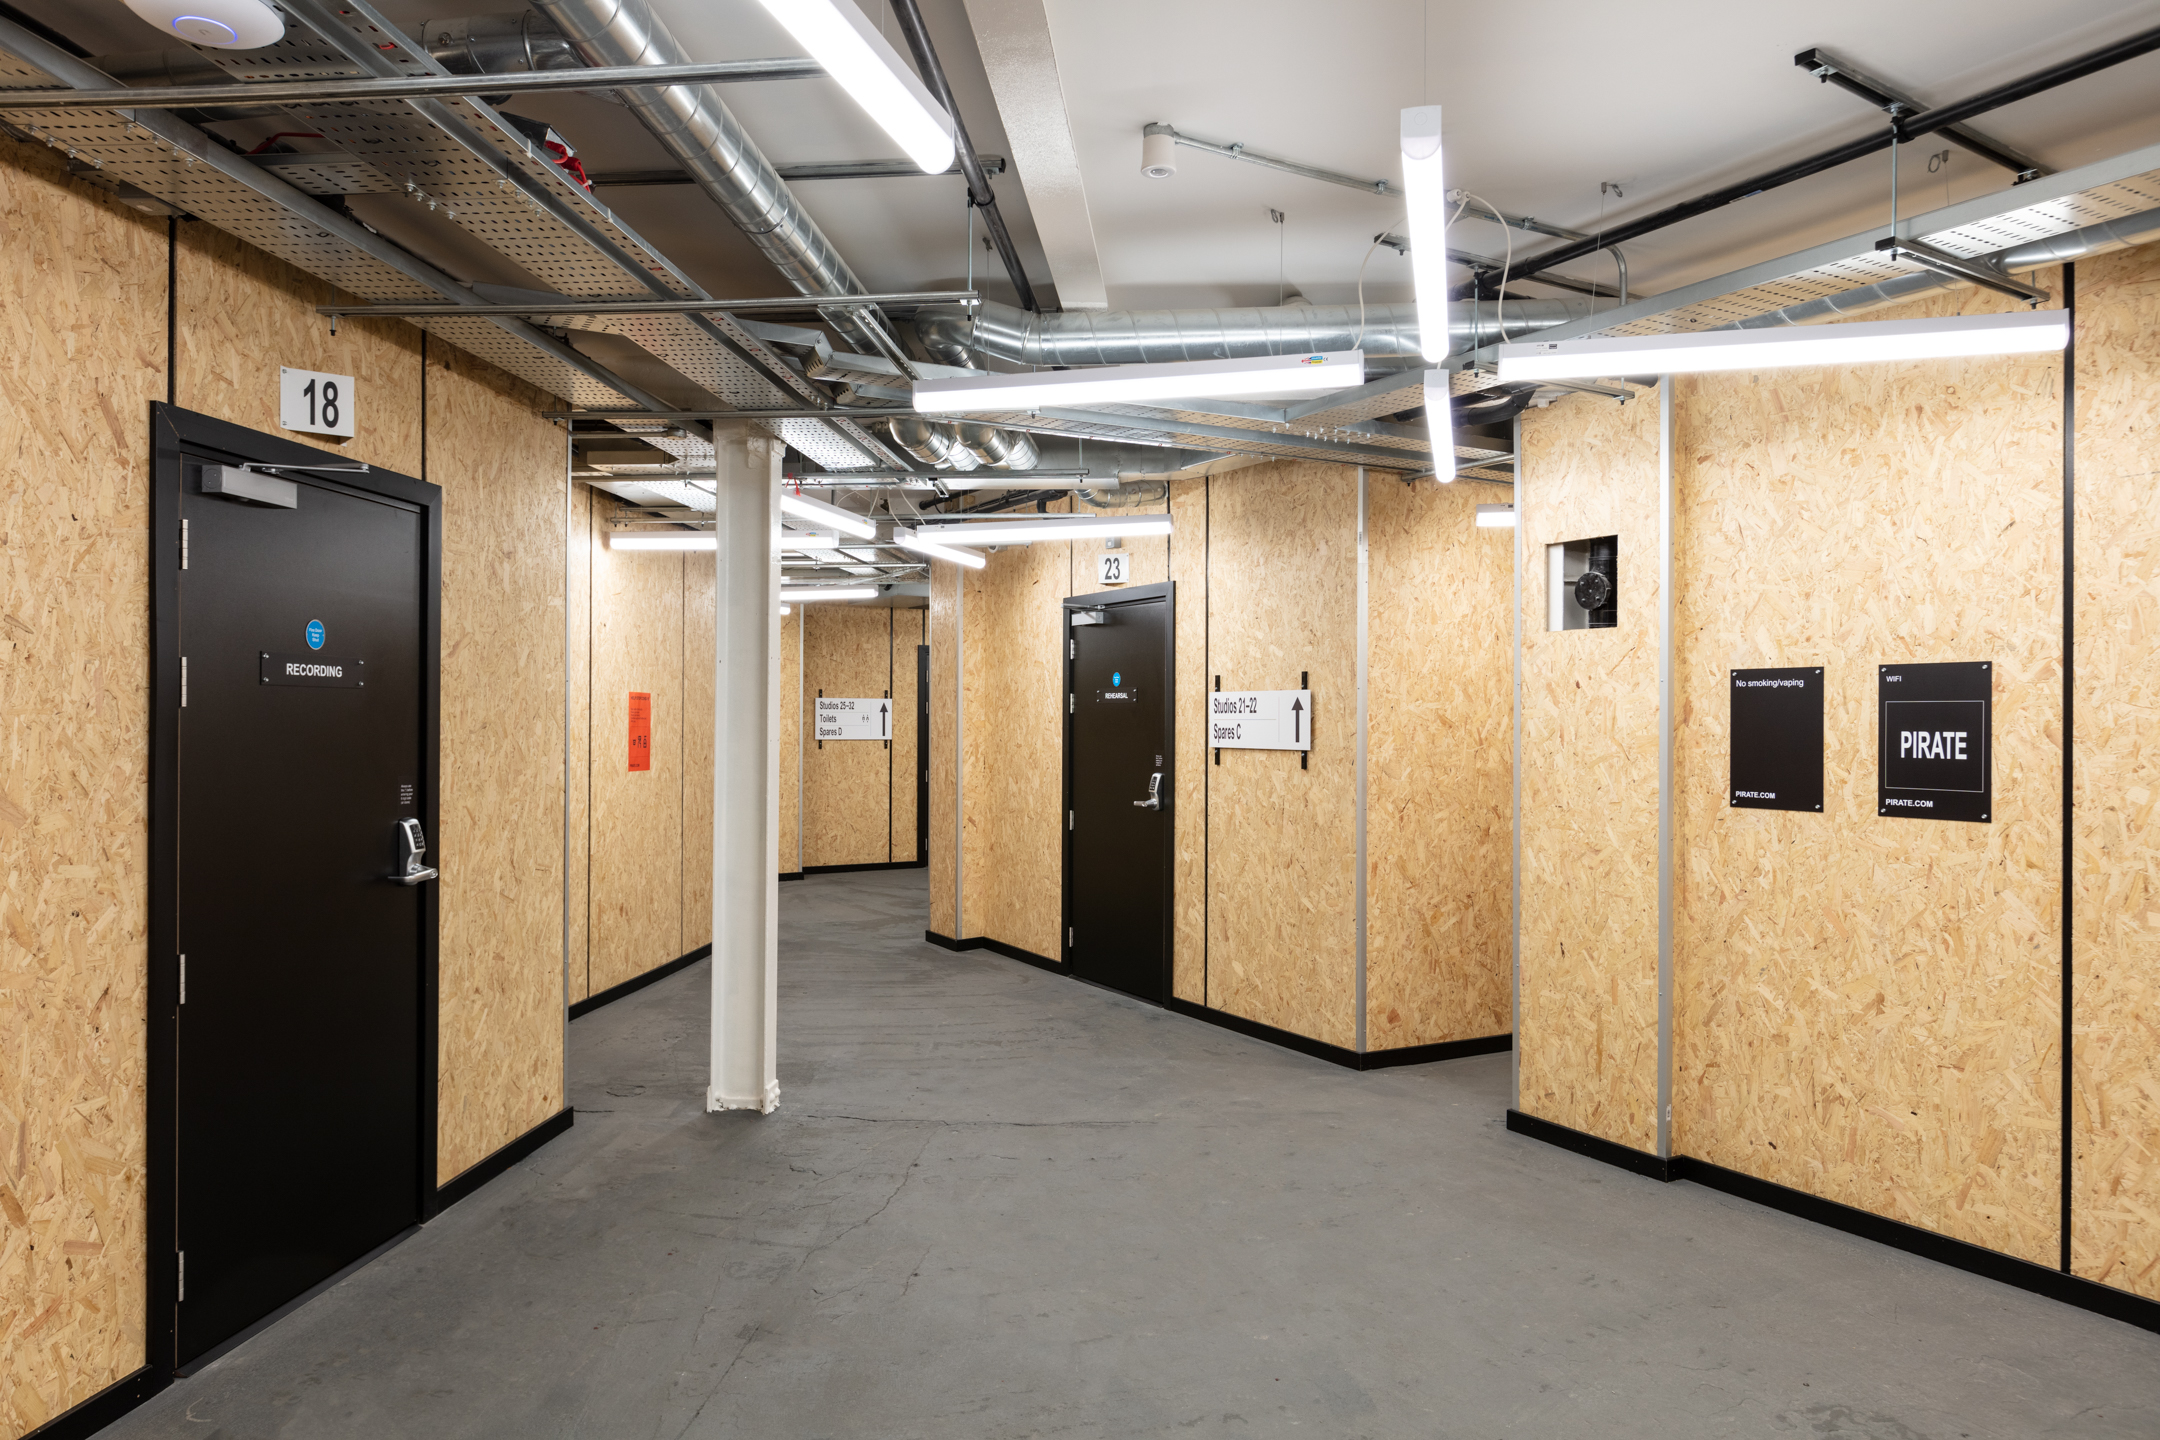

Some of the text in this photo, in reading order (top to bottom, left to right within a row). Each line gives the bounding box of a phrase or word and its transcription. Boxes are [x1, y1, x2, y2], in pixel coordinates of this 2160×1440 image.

[303, 378, 340, 429] 18
[1104, 557, 1121, 580] 23
[286, 662, 343, 678] RECORDING
[1735, 678, 1804, 689] No smoking/vaping
[819, 701, 839, 710] Studios
[1213, 697, 1237, 714] Studios
[819, 714, 837, 723] Toilets
[819, 727, 843, 738] Spares D
[1213, 723, 1242, 743] Spares C
[1900, 730, 1968, 760] PIRATE
[1735, 790, 1776, 799] PIRATE.COM
[1885, 798, 1934, 808] PIRATE.COM
